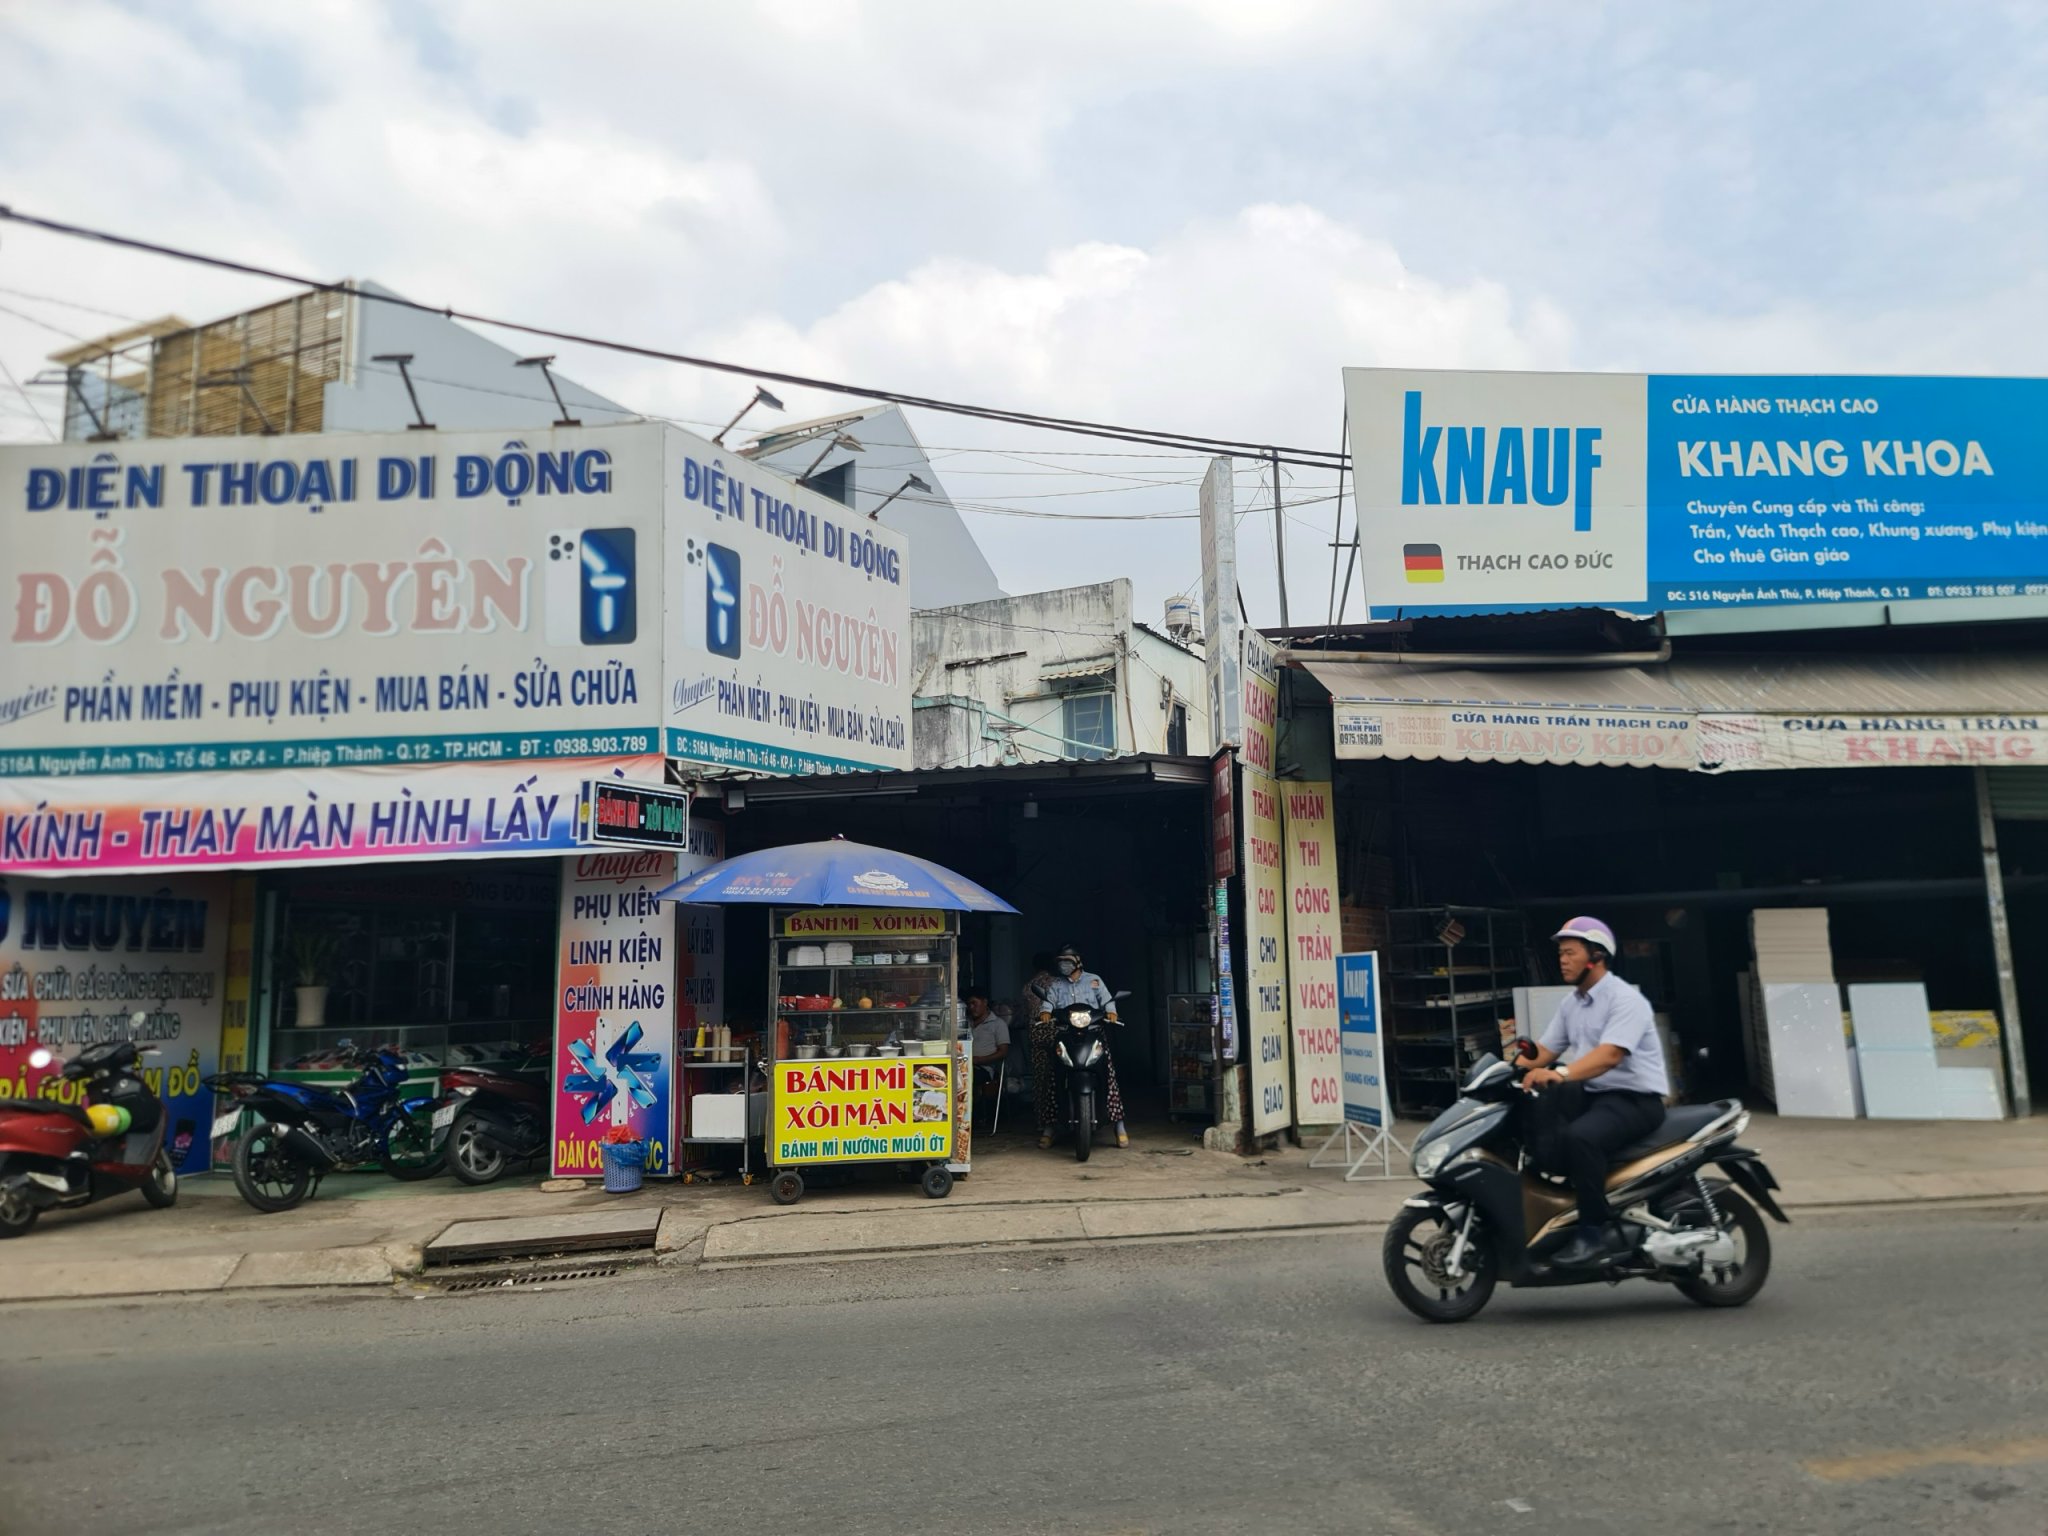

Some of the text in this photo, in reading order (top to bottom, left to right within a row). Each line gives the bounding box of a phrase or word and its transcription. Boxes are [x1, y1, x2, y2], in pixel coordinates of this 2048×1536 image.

[1672, 394, 1879, 418] CỬA HÀNG THẠCH CAO
[1677, 439, 1994, 478] KHANG KHOA
[26, 441, 612, 519] ĐIỆN THOẠI DI ĐỘNG
[684, 457, 900, 585] ĐIỆN THOẠI DI ĐỘNG
[1687, 497, 1926, 519] Chuyên Cung cấp và Thi công:
[1690, 522, 1731, 541] Trần,
[1736, 523, 1774, 539] Vách
[1780, 523, 1826, 542] Thạch
[1832, 526, 1865, 540] cao,
[1869, 522, 1920, 540] Khung
[1983, 520, 2011, 539] Phụ
[2016, 519, 2048, 539] kiện
[1457, 550, 1613, 574] THẠCH CAO ĐỨC
[1694, 546, 1850, 565] Cho thuê Giàn giáo
[12, 527, 533, 644] ĐỖ NGUYÊN
[1667, 591, 1686, 602] ĐC:
[1690, 590, 1709, 601] 516
[1896, 586, 1910, 598] 12
[749, 554, 898, 687] ĐỖ NGUYÊN
[1248, 632, 1260, 671] CỬA
[64, 657, 638, 725] PHẦN MỀM PHỤ KIỆN MUA BÁN SỬA CHỮA
[1245, 679, 1276, 729] KHANG
[718, 668, 745, 718] PHẦN
[748, 674, 771, 723] MỀM
[779, 694, 797, 736] PHỤ
[800, 693, 820, 739] KIỆN
[828, 706, 845, 737] MUA
[847, 704, 863, 742] BÁN
[870, 705, 885, 747] SỬA
[886, 714, 905, 751] CHỮA
[1451, 711, 1487, 724] CỬA
[1492, 713, 1540, 725] HÀNG
[1597, 718, 1651, 730] THẠCH
[1656, 720, 1689, 730] CAO
[1783, 713, 1848, 731] CỬA
[1860, 716, 1946, 731] HÀNG
[39, 749, 96, 776] Nguyễn
[199, 751, 216, 766] 46
[229, 747, 266, 766] KP.4
[397, 745, 430, 761] Q.12
[443, 741, 503, 759] TP.HCM
[519, 739, 541, 756] ĐT
[554, 736, 647, 755] 0938.903.789
[677, 735, 688, 752] ĐC
[1246, 727, 1270, 771] KHOA
[1454, 728, 1583, 756] KHANG
[1591, 732, 1692, 759] KHOA
[1842, 735, 2036, 763] KHANG
[2, 800, 103, 861] KÍNH
[140, 806, 247, 858] THAY
[255, 790, 354, 853] MÀN
[366, 787, 470, 848] HÌNH
[481, 774, 559, 843] LẤY
[598, 791, 626, 828] BÁNH
[645, 798, 661, 831] XÔI
[1252, 783, 1275, 821] TRẦN
[1251, 836, 1280, 873] THẠCH
[1300, 841, 1321, 867] THI
[574, 884, 661, 926] PHỤ KIỆN
[1258, 887, 1275, 915] CAO
[1295, 883, 1331, 914] CÔNG
[21, 887, 207, 951] NGUYÊN
[791, 913, 939, 933] BÁNH MÌ XÔI MẶN
[570, 931, 662, 970] LINH KIỆN
[1260, 936, 1277, 963] CHO
[1298, 925, 1333, 961] TRẦN
[564, 977, 665, 1013] CHÍNH HÃNG
[1259, 979, 1281, 1012] THUÊ
[1299, 976, 1336, 1010] VÁCH
[1261, 1029, 1282, 1063] GIÀN
[1298, 1028, 1341, 1063] THẠCH
[786, 1063, 906, 1093] BÁNH MÌ
[1311, 1077, 1338, 1104] CAO
[1264, 1076, 1284, 1115] GIÁO
[786, 1099, 906, 1130] XÔI MẶN
[558, 1132, 585, 1169] DÁN
[781, 1132, 945, 1158] BÁNH MÌ NƯỚNG MUỐI ỚT
